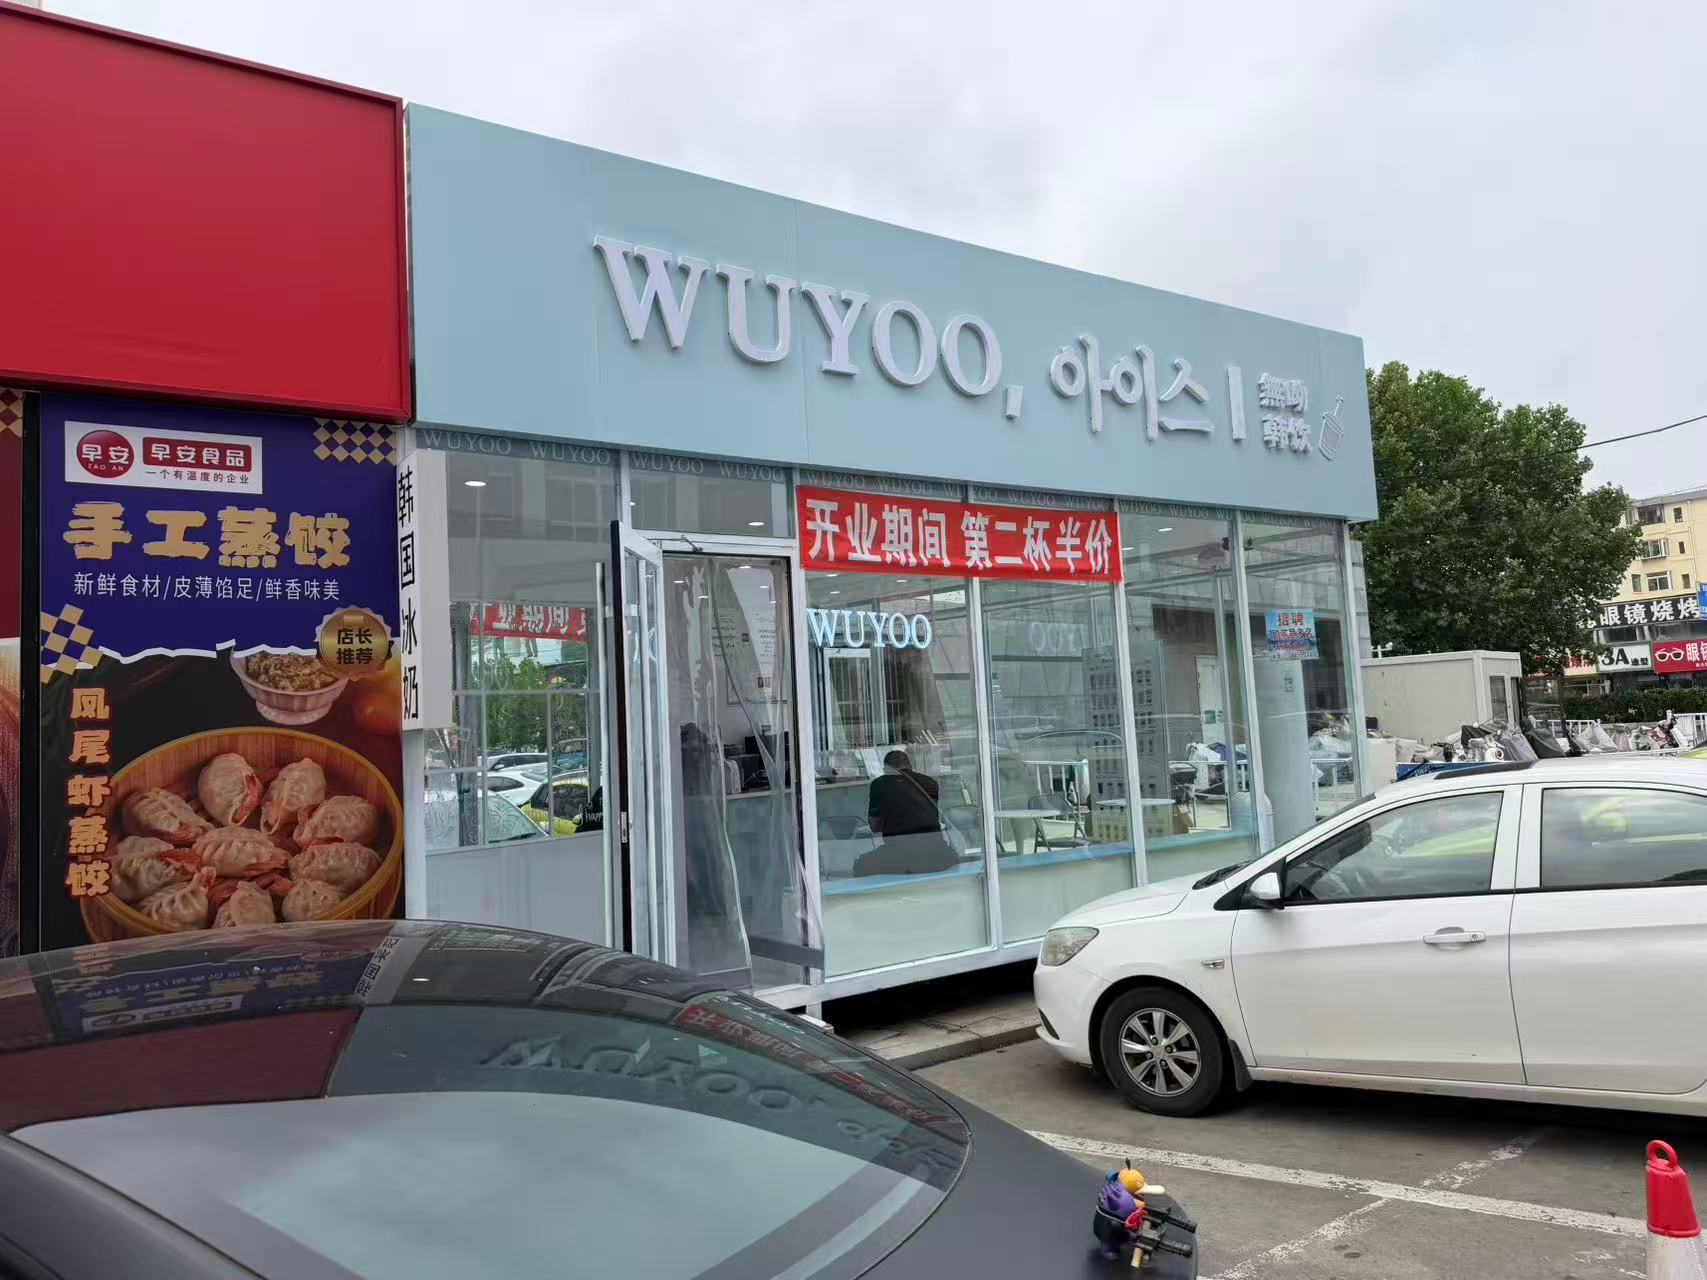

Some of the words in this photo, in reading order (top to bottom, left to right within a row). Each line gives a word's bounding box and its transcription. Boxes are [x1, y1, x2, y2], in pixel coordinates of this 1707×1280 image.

[1050, 335, 1215, 441] 아이스
[82, 443, 129, 464] 早安
[151, 443, 245, 467] 早安食品
[423, 430, 512, 455] WUYOO
[530, 440, 610, 465] WUYOO
[632, 453, 704, 474] WUYOO
[720, 462, 785, 482] WUYOO
[807, 472, 865, 488] WUYOO
[877, 479, 932, 495] WUYOO
[145, 468, 249, 484] 一个有温度的企业
[63, 501, 351, 569] 手工蒸饺
[806, 498, 950, 568] 开业期间
[960, 511, 1112, 575] 第二杯半价
[73, 572, 341, 601] 新鲜食材/皮薄馅足/鲜香味美
[398, 465, 419, 720] 韩国冰奶
[806, 608, 932, 649] WUYOO
[1577, 597, 1699, 628] 眼镜烧烤
[336, 628, 373, 645] 店长
[336, 647, 374, 666] 推荐
[65, 687, 112, 896] 凤尾虾蒸饺
